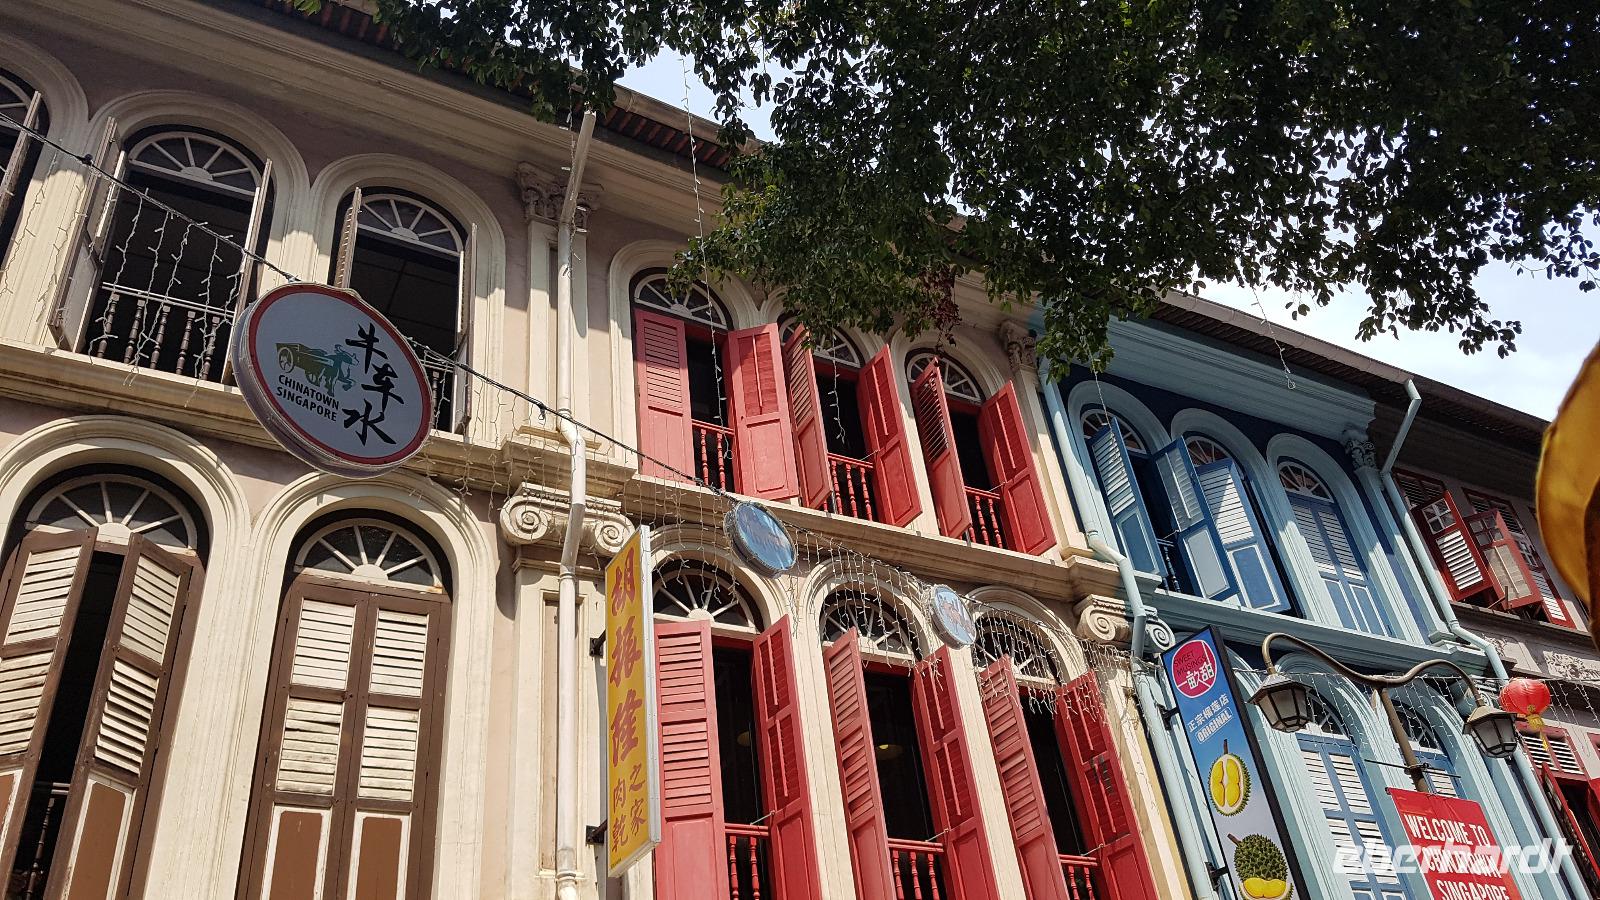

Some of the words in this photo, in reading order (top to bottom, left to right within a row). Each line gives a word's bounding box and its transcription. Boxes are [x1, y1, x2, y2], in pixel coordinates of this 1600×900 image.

[276, 387, 337, 421] SINGAPORE
[278, 375, 339, 410] CHINATOWN
[610, 547, 642, 768] 胡振隆
[1174, 651, 1195, 668] SWEET
[1197, 709, 1232, 742] ORIGINAL
[629, 762, 647, 837] 之家
[1404, 813, 1474, 846] WELCOME
[1469, 824, 1490, 848] TO
[1421, 846, 1502, 879] CHINATOWN
[1436, 879, 1511, 900] SINGAPORE
